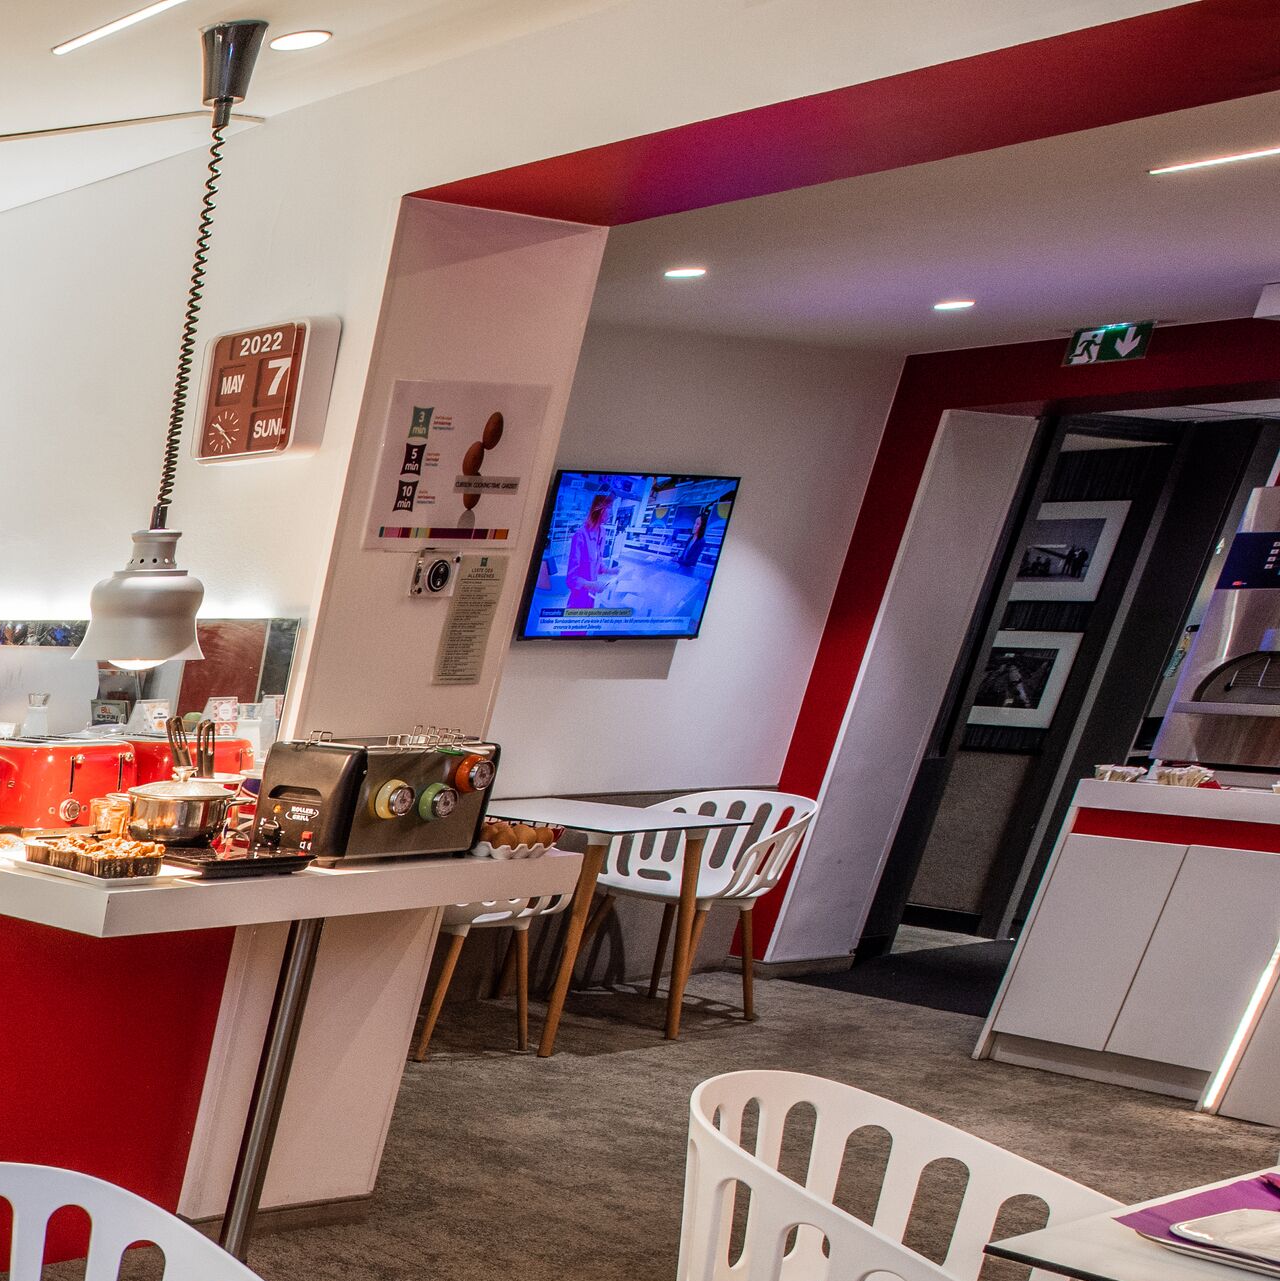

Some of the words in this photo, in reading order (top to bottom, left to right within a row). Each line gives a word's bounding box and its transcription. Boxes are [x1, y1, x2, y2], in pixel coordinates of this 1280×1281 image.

[240, 332, 283, 356] 2022
[268, 357, 291, 396] 7
[220, 374, 245, 395] MAY
[418, 411, 425, 422] 3
[412, 423, 427, 434] min
[411, 448, 418, 459] 5
[404, 460, 419, 471] min
[402, 485, 413, 497] 10
[396, 497, 411, 508] min
